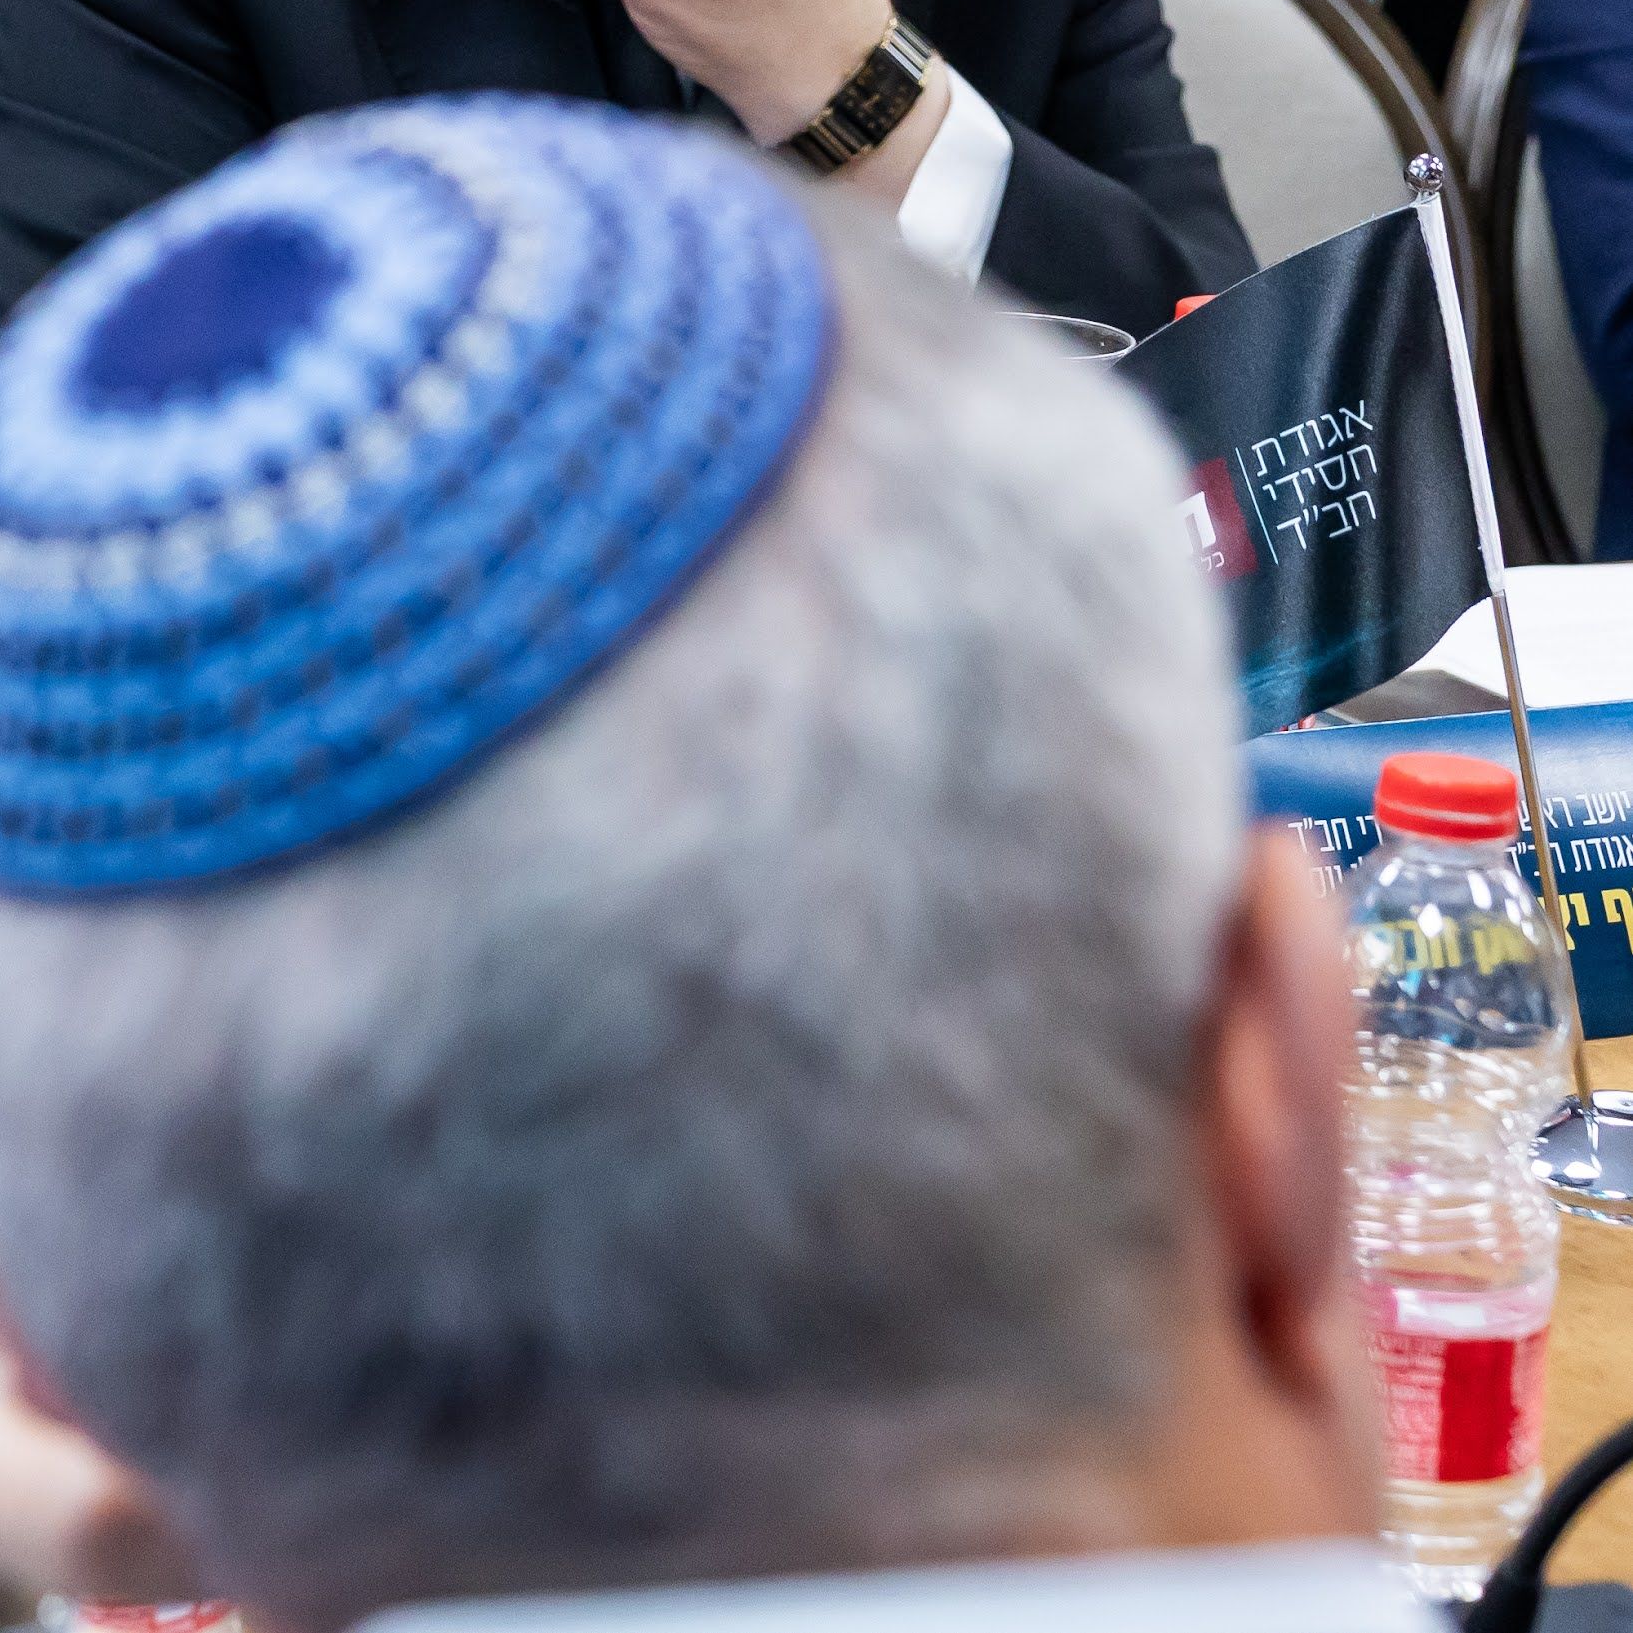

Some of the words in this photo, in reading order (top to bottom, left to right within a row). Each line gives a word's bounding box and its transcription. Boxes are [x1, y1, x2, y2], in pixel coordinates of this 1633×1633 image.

[1251, 399, 1374, 477] אגודת
[1262, 443, 1378, 504] חסידי
[1276, 490, 1377, 550] חב"ד
[1575, 790, 1632, 827] יושב
